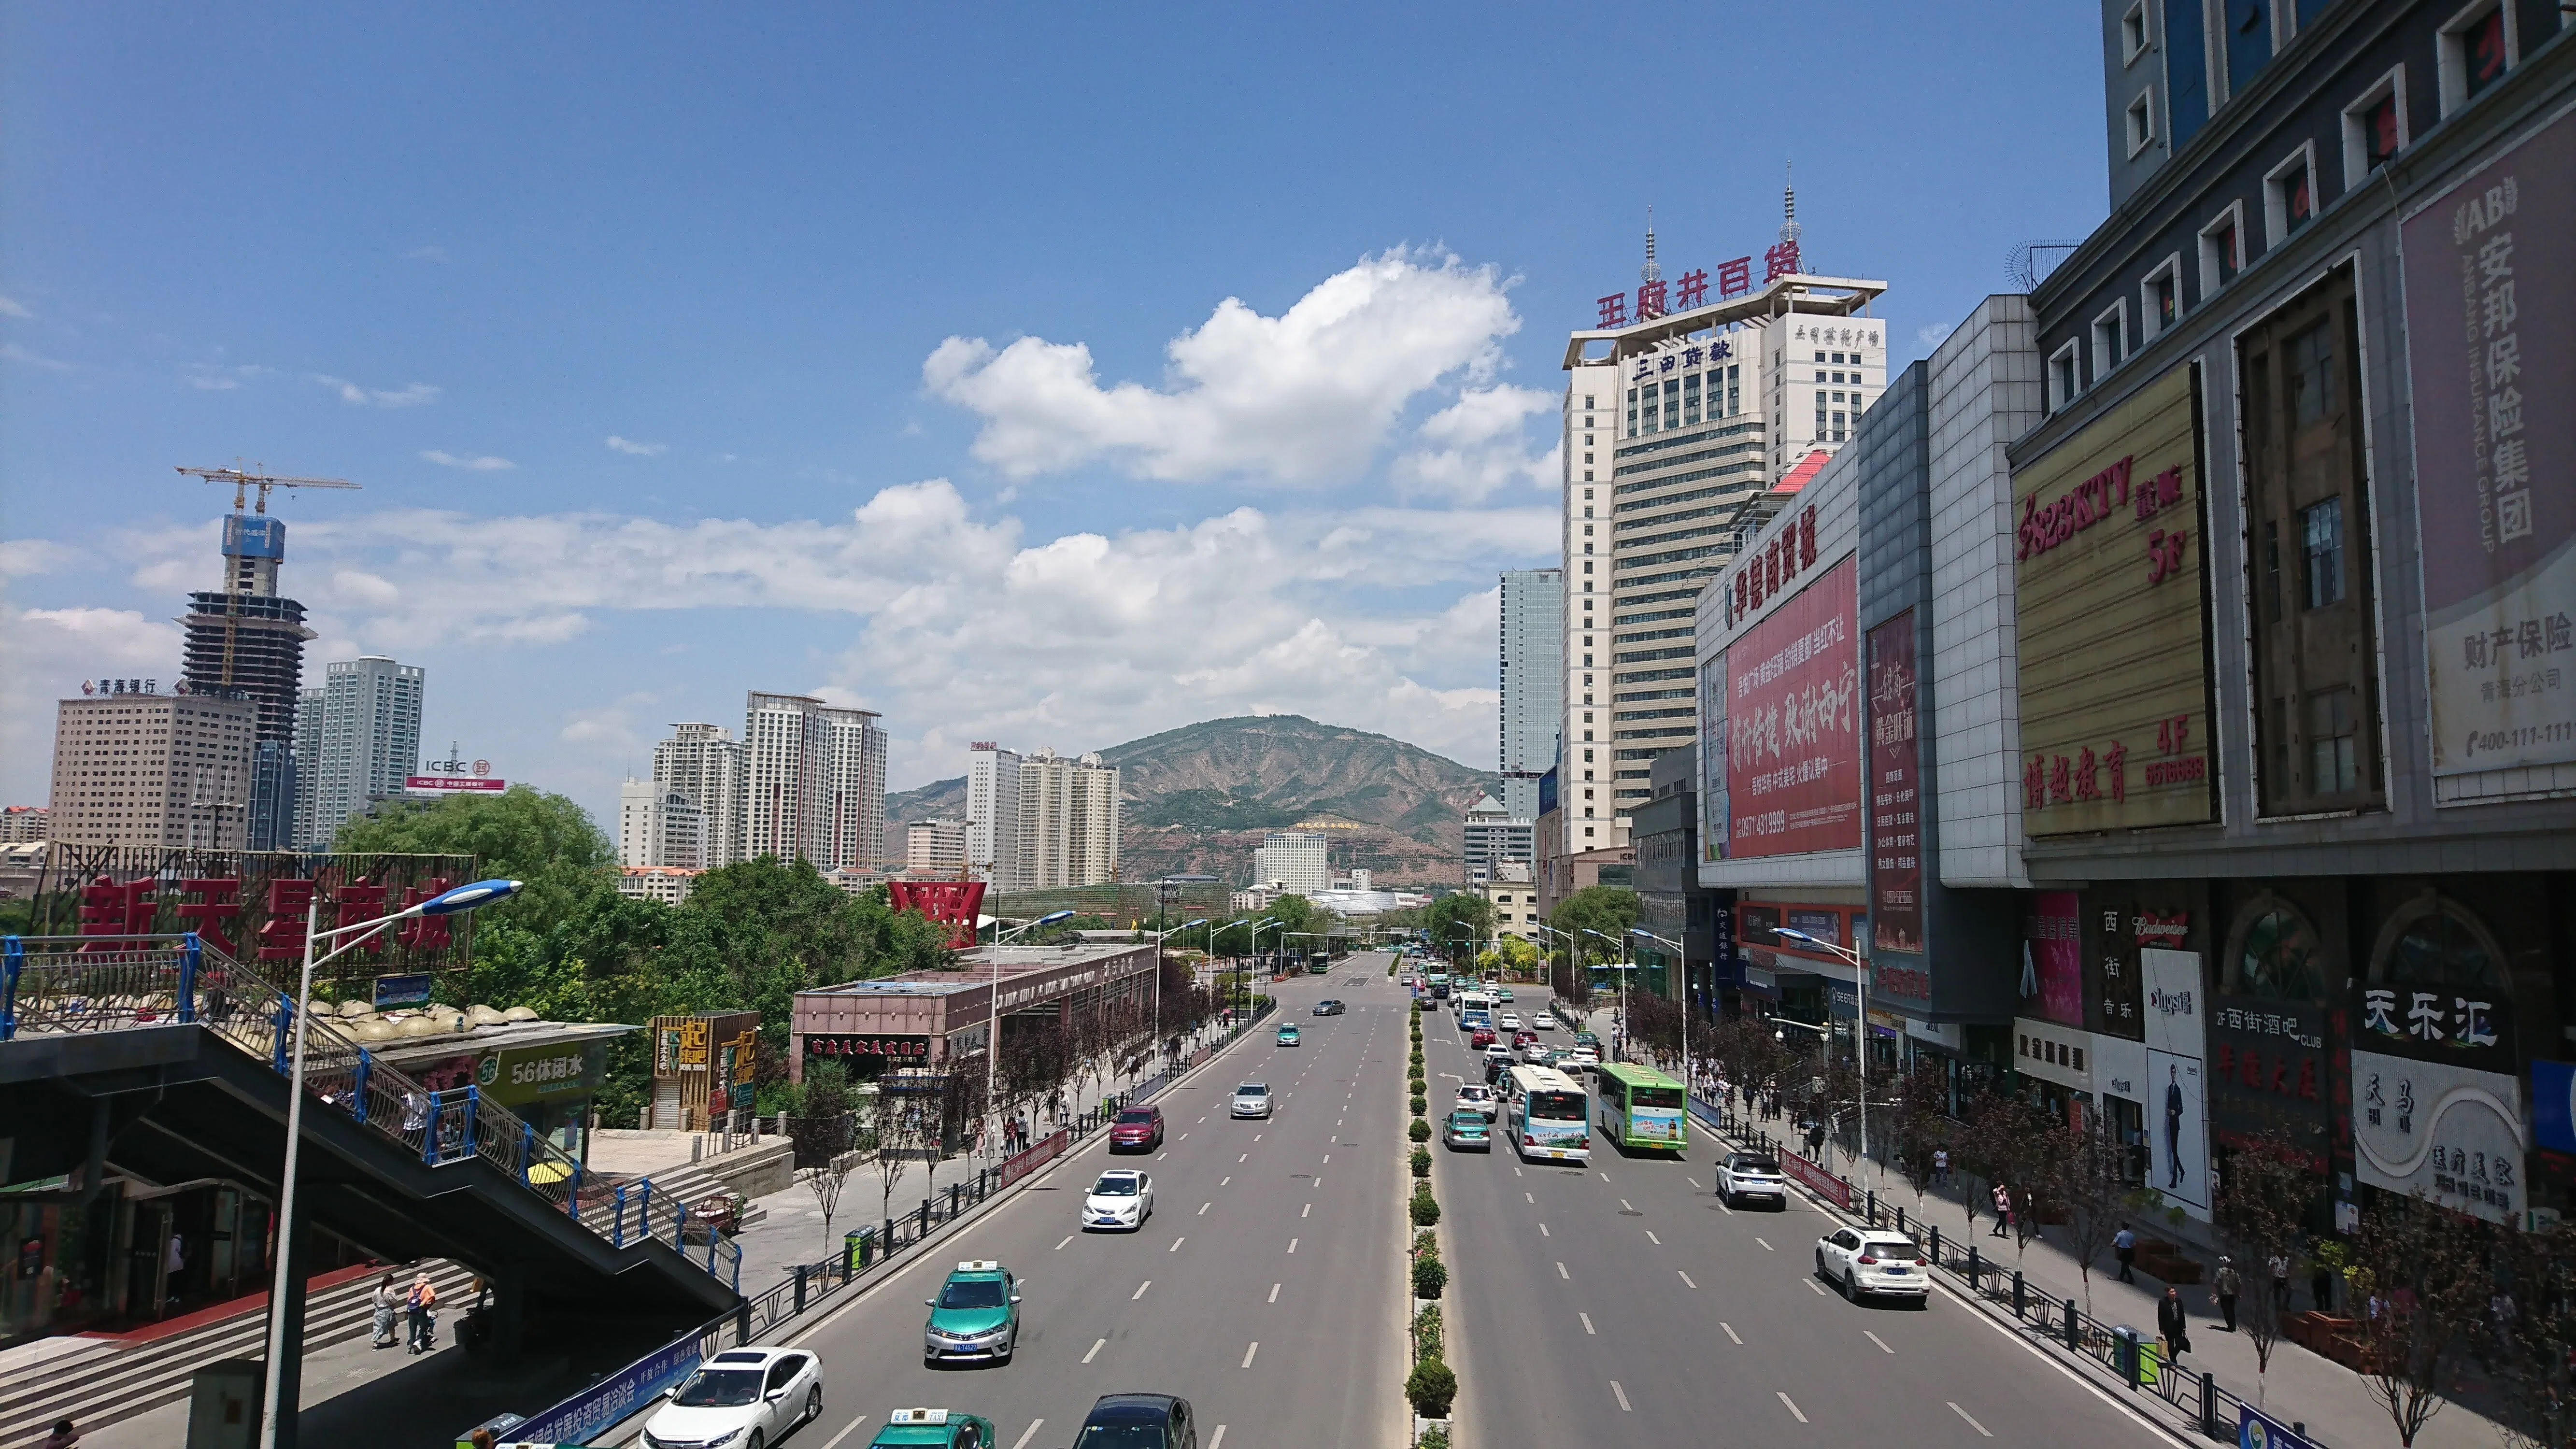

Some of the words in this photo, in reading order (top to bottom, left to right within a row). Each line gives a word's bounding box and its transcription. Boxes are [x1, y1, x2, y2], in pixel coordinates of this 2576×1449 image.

[1596, 241, 1799, 329] 王府井百货
[2479, 232, 2533, 544] 安邦保险集团
[1733, 504, 1817, 621] 华德商贸城
[2148, 529, 2186, 586] 5F
[2463, 612, 2574, 671] 财产保险
[99, 679, 155, 694] 青海银行
[2481, 668, 2560, 703] 青海分公司
[2157, 714, 2189, 756] 4F
[2478, 722, 2576, 752] 400-111-111
[426, 760, 466, 772] ICBC
[1719, 921, 1728, 960] 交通銀行
[2103, 910, 2120, 980] 西街
[2132, 916, 2189, 936] Budweiser
[2103, 997, 2133, 1019] 音乐
[2227, 1008, 2300, 1040] 西街酒吧
[2365, 990, 2498, 1047] 天乐汇
[2301, 1035, 2321, 1048] CLUB
[2365, 1073, 2415, 1114] 天马
[640, 1359, 668, 1384] 开放合作
[519, 1378, 635, 1445] 海绿色发展投资贸易洽谈会
